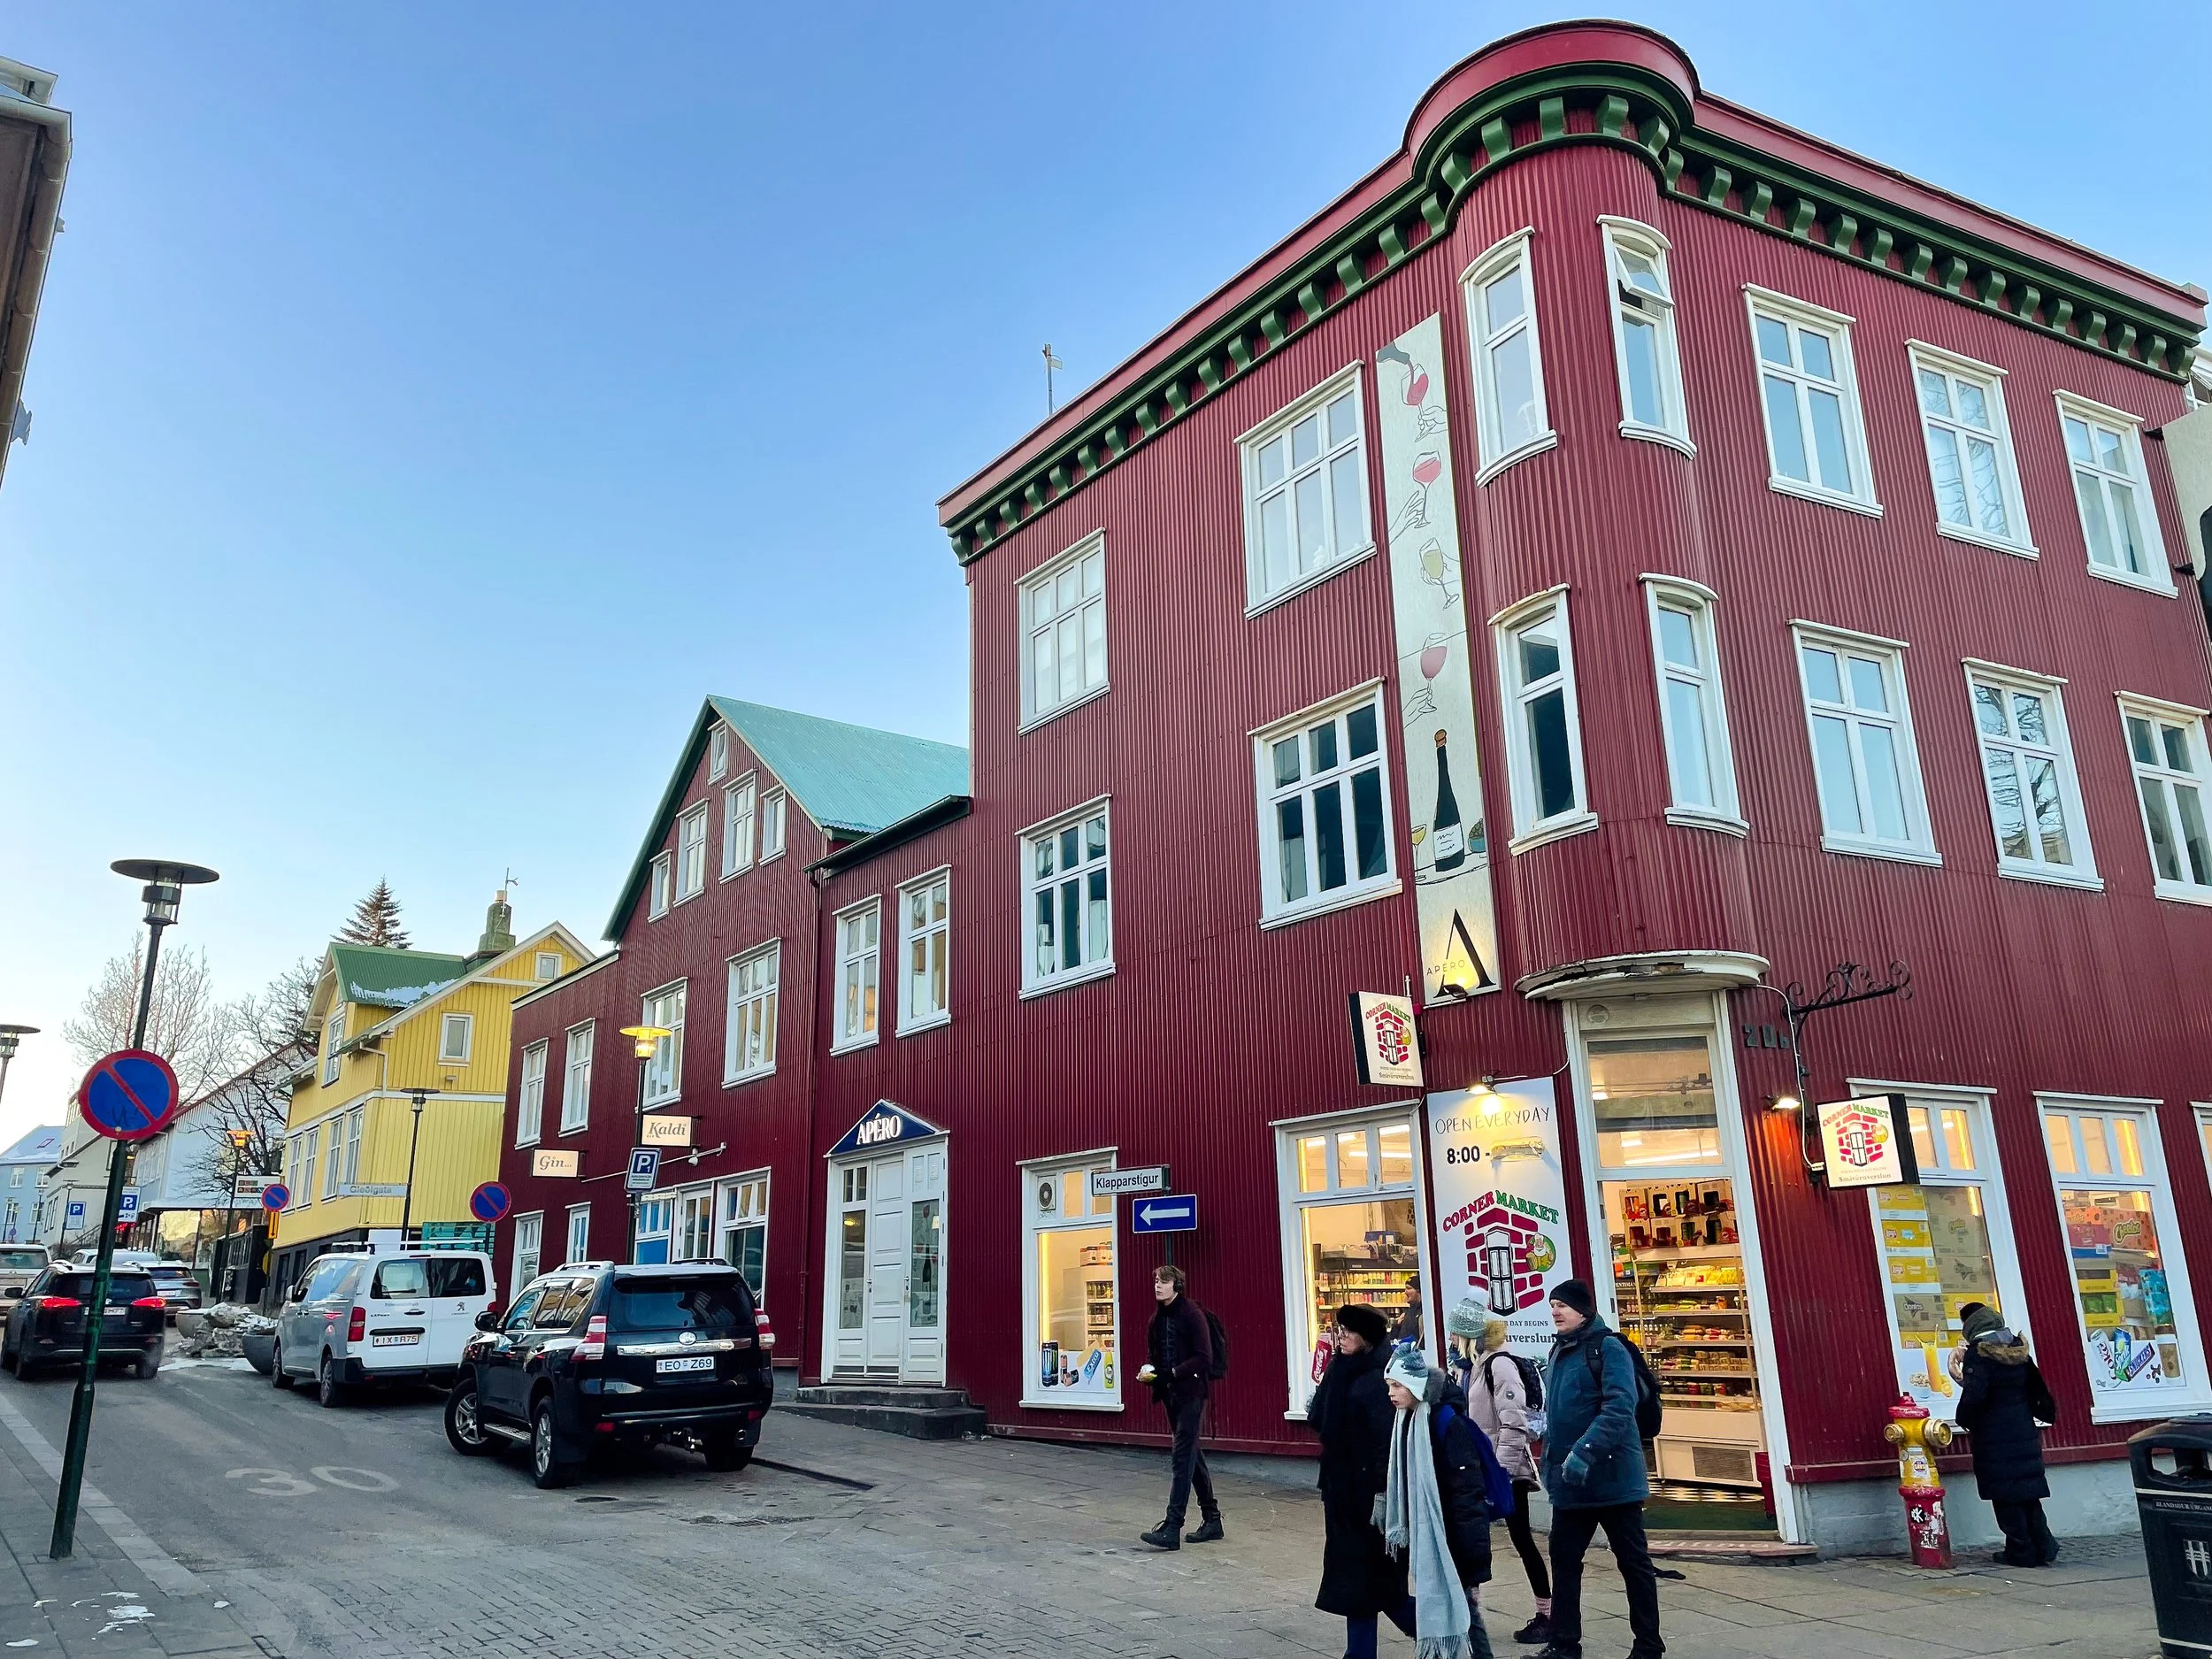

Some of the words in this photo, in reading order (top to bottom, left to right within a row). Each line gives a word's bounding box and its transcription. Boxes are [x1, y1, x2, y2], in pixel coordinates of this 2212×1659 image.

[1365, 1002, 1386, 1020] CORNER
[1386, 1002, 1411, 1023] MARKET
[1823, 1104, 1852, 1127] CORNER
[1852, 1102, 1889, 1119] MARKET
[856, 1112, 902, 1146] APÉRO
[1435, 1117, 1472, 1135] OPEN
[1447, 1145, 1480, 1164] 8:00
[1095, 1172, 1159, 1190] Klapparstígur
[73, 1204, 81, 1214] P
[1442, 1191, 1495, 1233] CORNER
[1494, 1189, 1559, 1225] MARKET
[1505, 1333, 1555, 1344] uverslun
[664, 1361, 681, 1371] EO
[690, 1358, 712, 1369] Z69
[225, 1466, 400, 1496] 30
